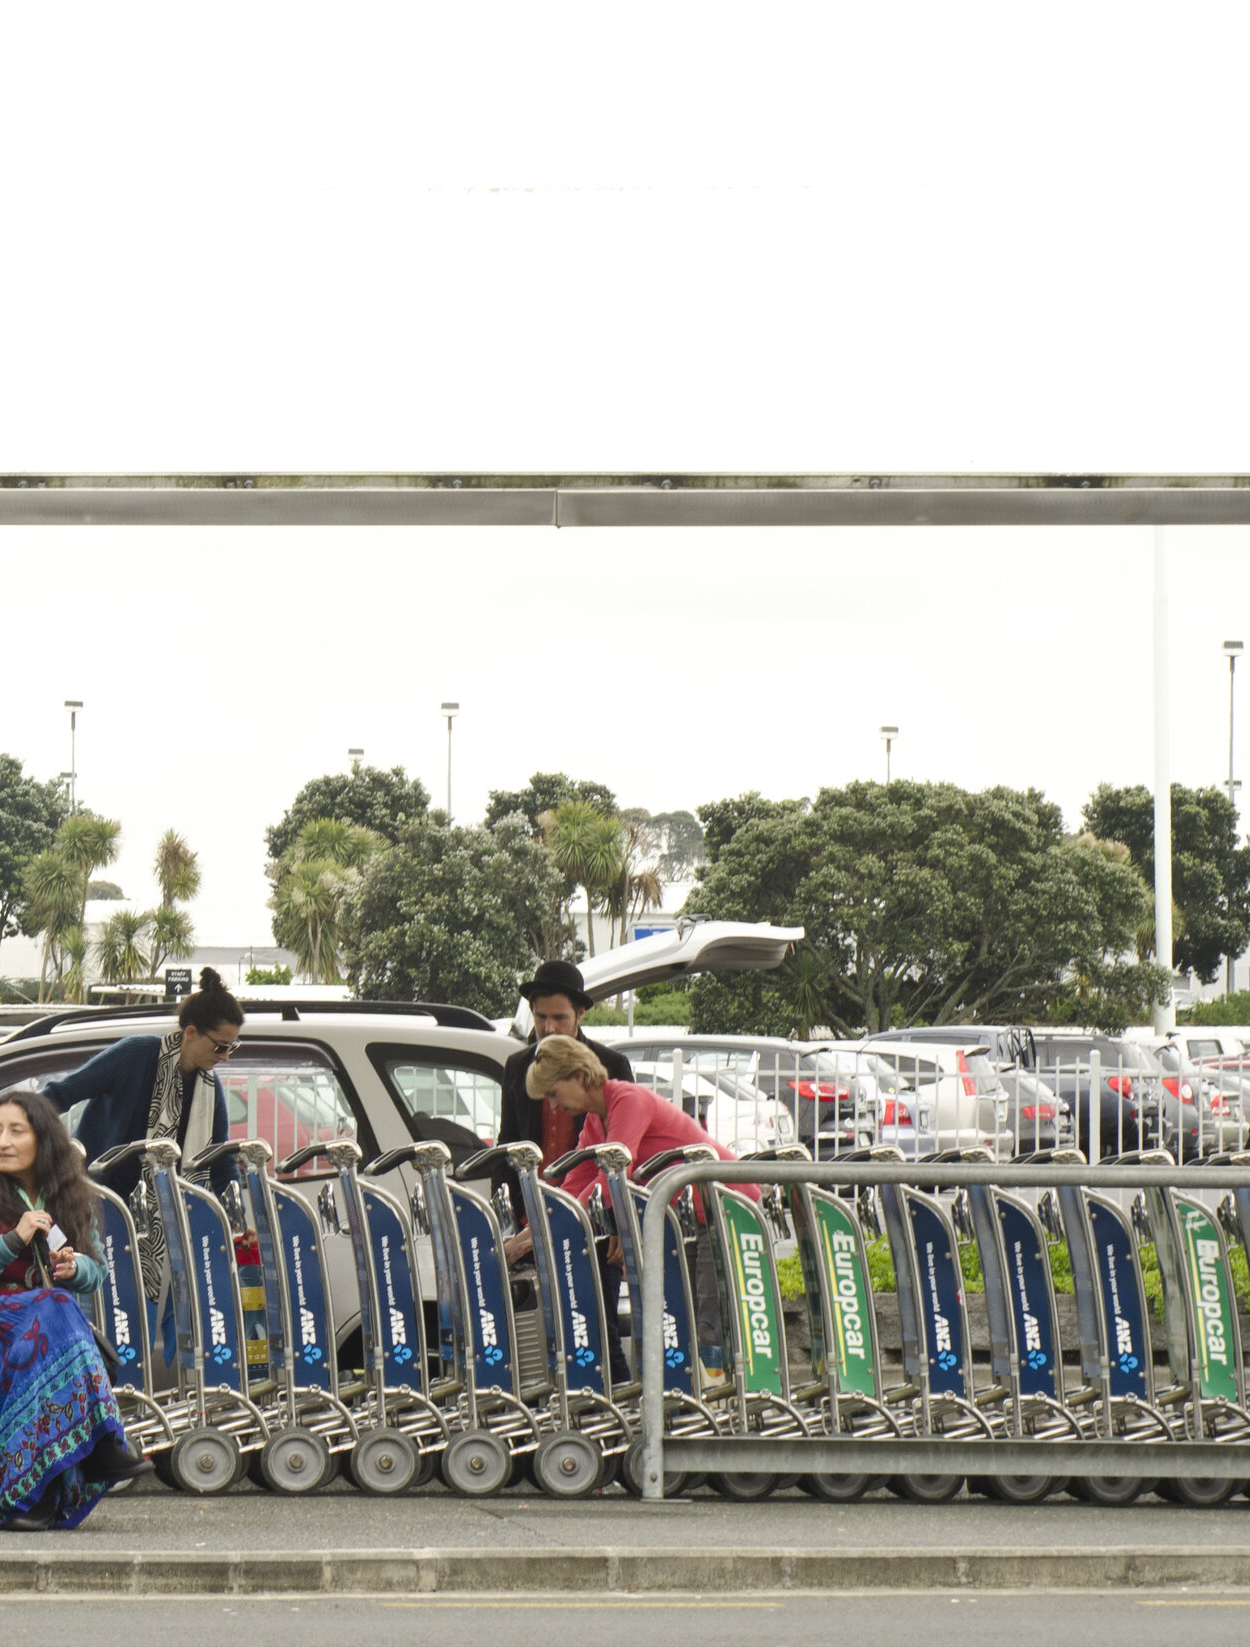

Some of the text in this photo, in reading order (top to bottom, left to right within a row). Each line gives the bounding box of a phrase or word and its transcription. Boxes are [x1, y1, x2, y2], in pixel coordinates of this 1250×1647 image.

[740, 1232, 772, 1359] Europcar
[832, 1232, 865, 1360] Europcar
[1196, 1239, 1228, 1366] Europcar
[114, 1307, 130, 1345] ANZ
[210, 1307, 226, 1345] ANZ
[300, 1307, 316, 1345] ANZ
[389, 1307, 406, 1345] ANZ
[480, 1309, 497, 1347] ANZ
[572, 1310, 588, 1348] ANZ
[663, 1312, 678, 1350] ANZ
[934, 1313, 951, 1352] ANZ
[1023, 1313, 1041, 1351] ANZ
[1115, 1316, 1132, 1354] ANZ
